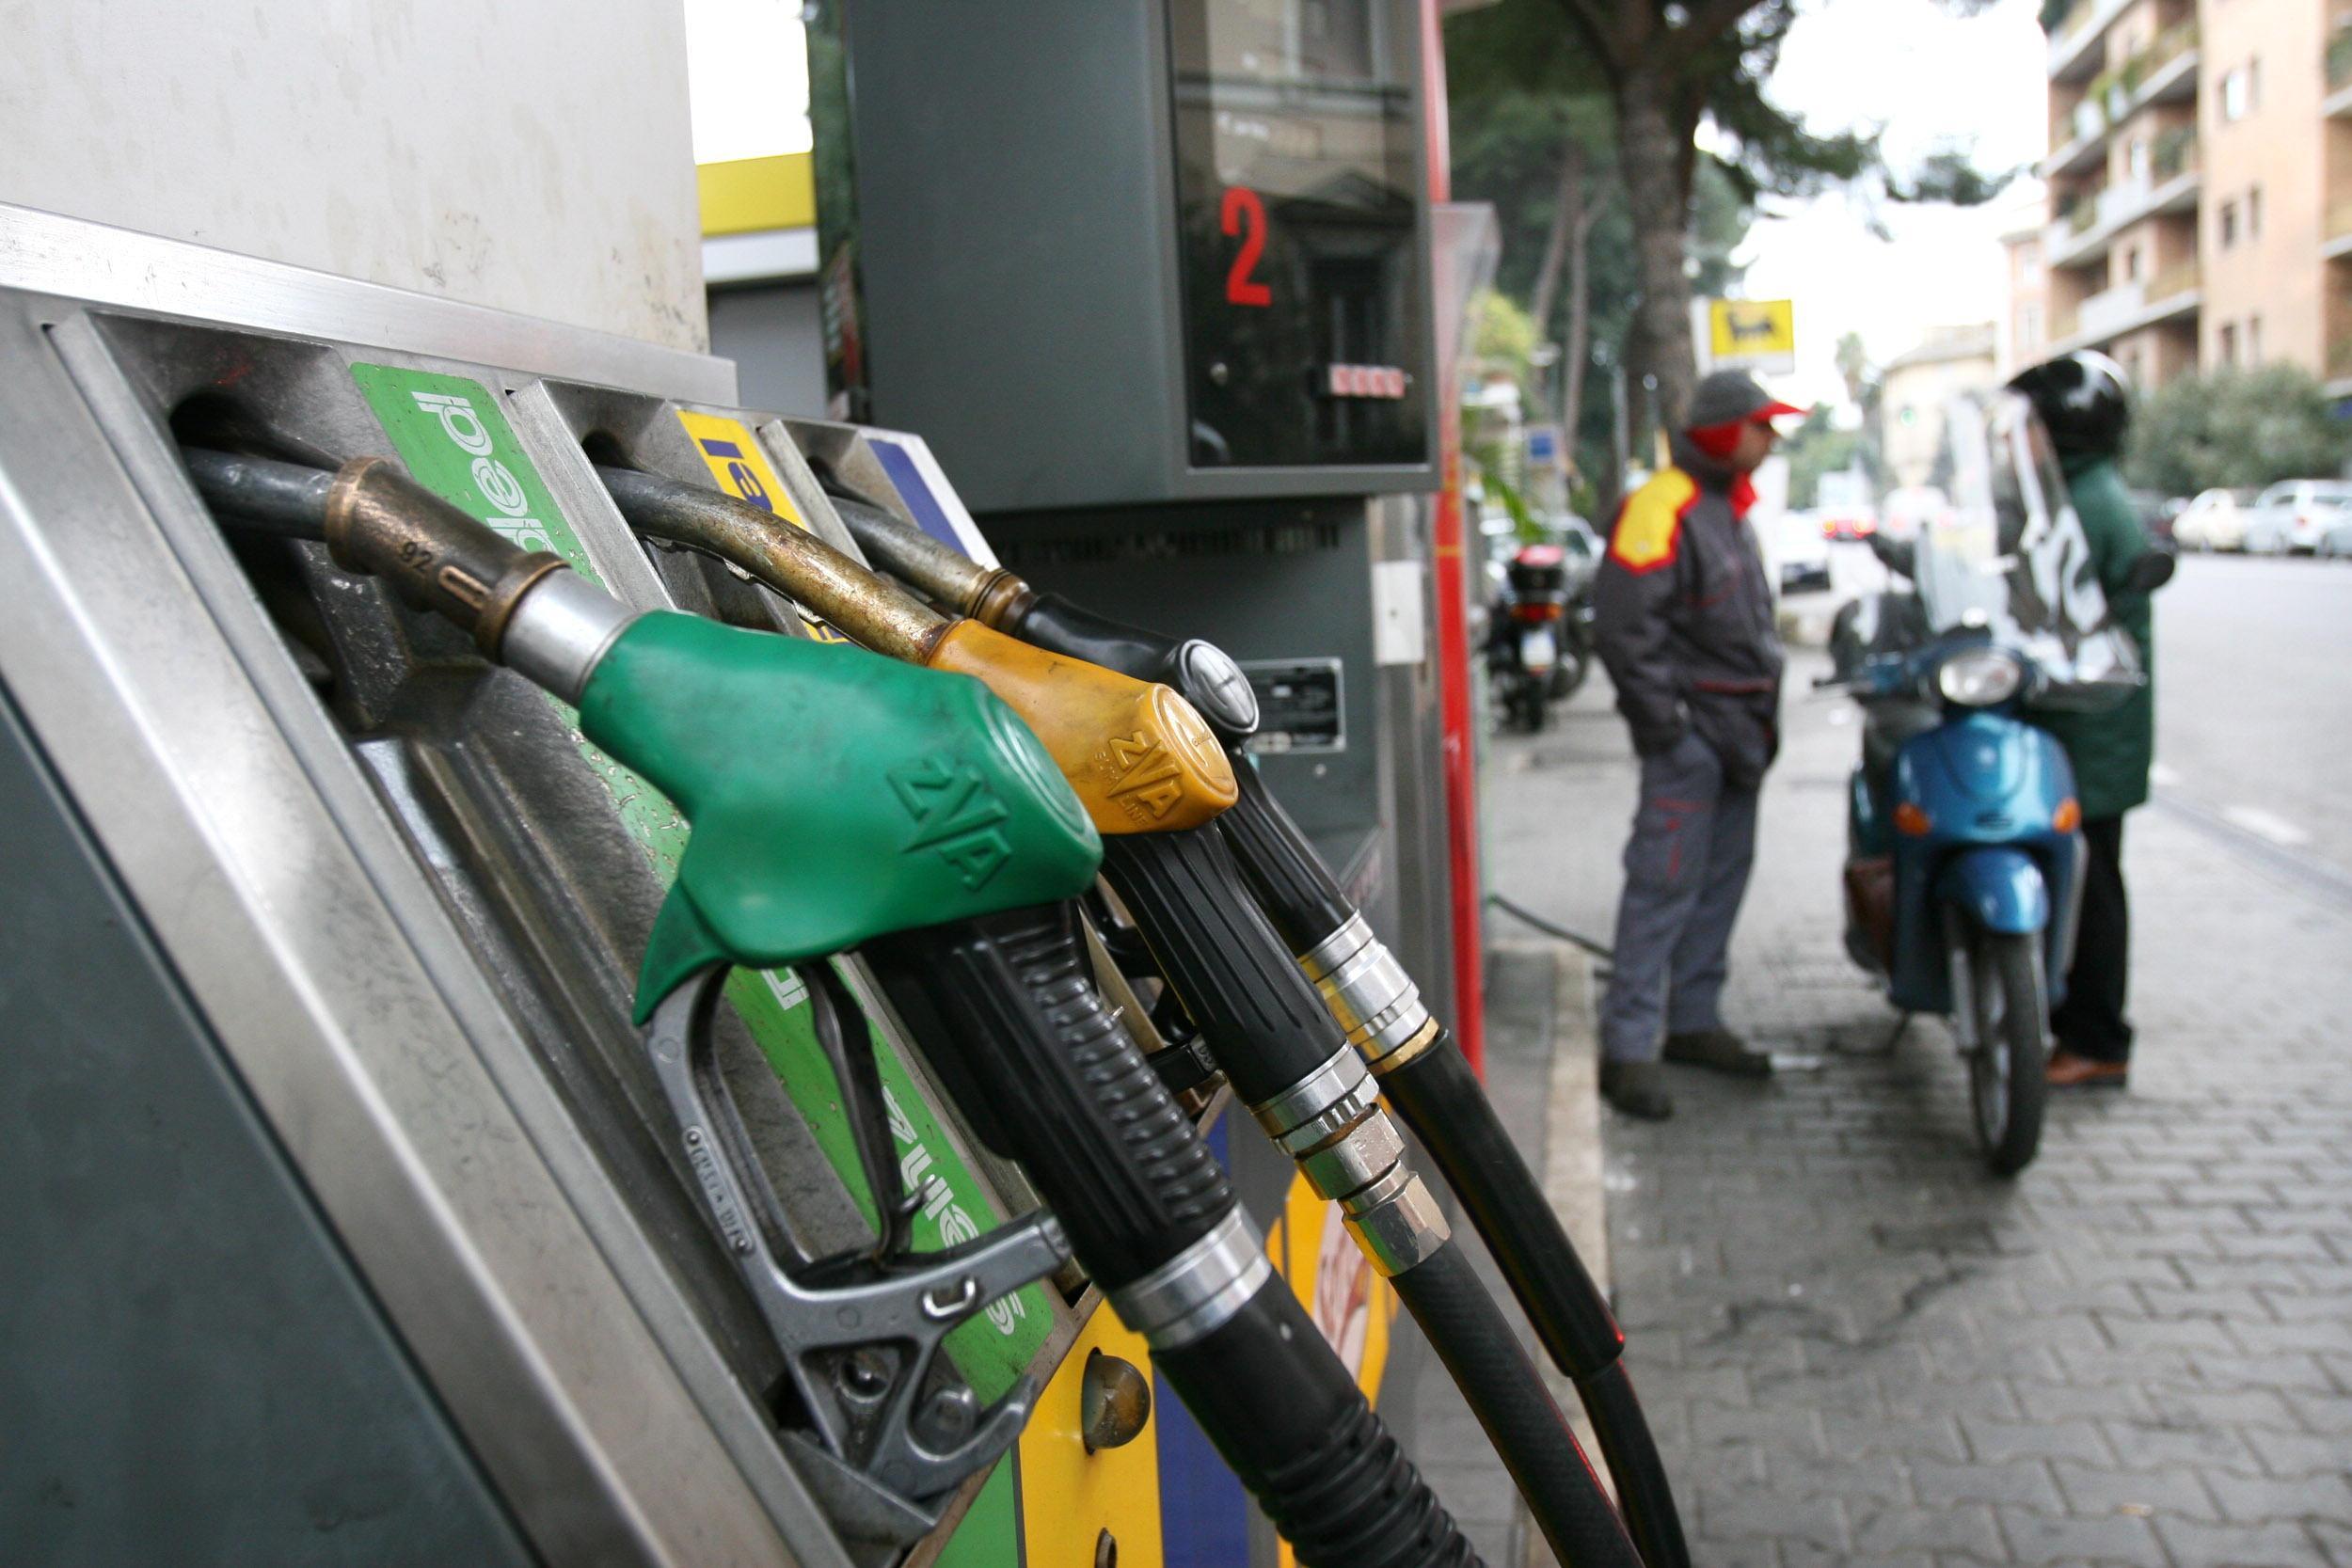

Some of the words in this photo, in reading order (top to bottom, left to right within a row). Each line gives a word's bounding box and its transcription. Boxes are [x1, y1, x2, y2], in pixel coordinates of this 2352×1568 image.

[1220, 185, 1272, 307] 2
[886, 754, 1012, 893] ZVA
[1107, 730, 1182, 821] ZVA
